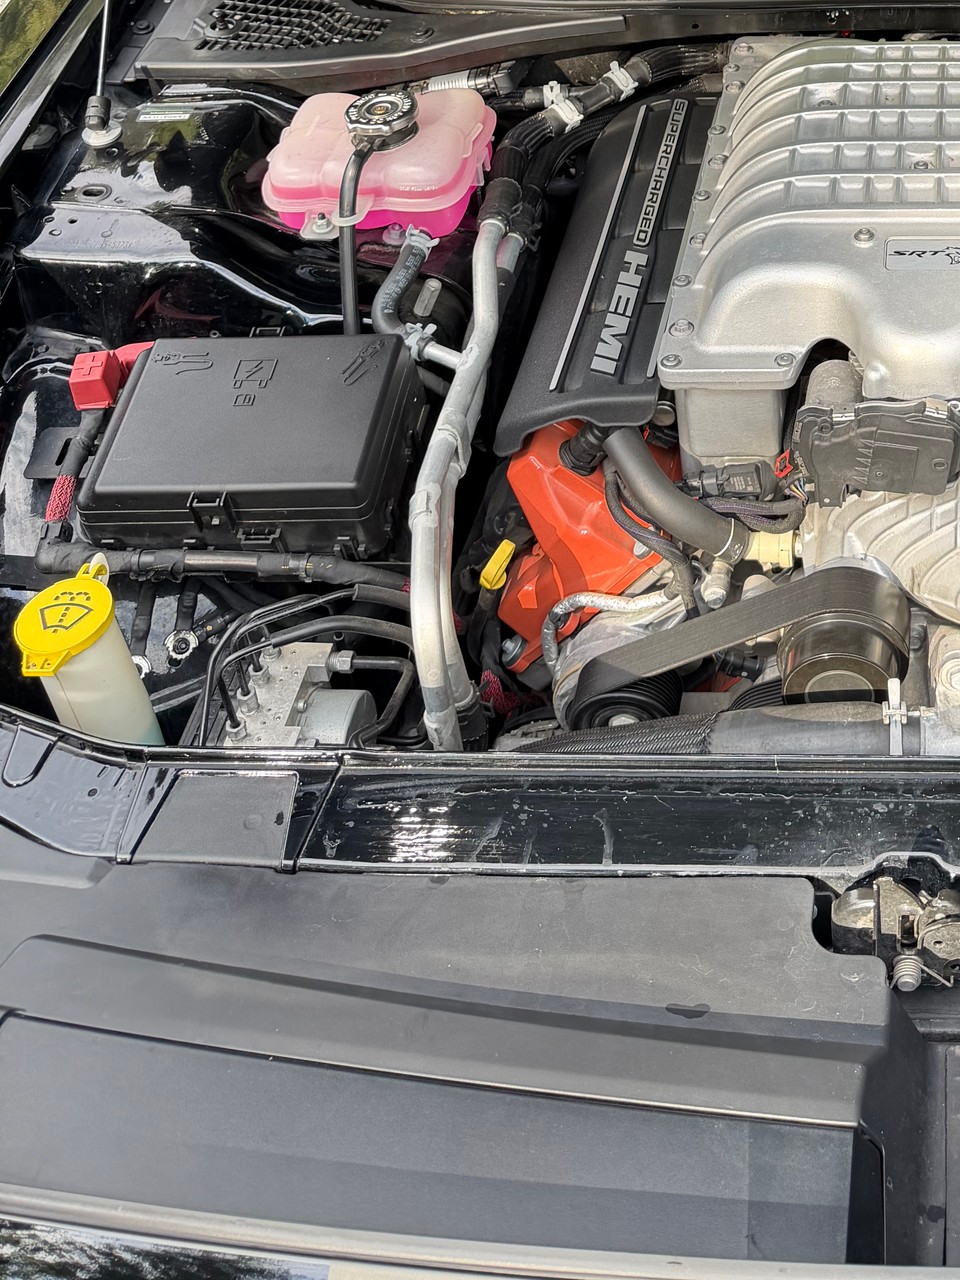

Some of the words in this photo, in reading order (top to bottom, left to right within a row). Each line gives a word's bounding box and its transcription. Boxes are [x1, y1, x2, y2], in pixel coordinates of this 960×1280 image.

[635, 99, 687, 243] SUPERCHARGED
[590, 250, 649, 375] HEMI
[888, 250, 946, 258] SRT
